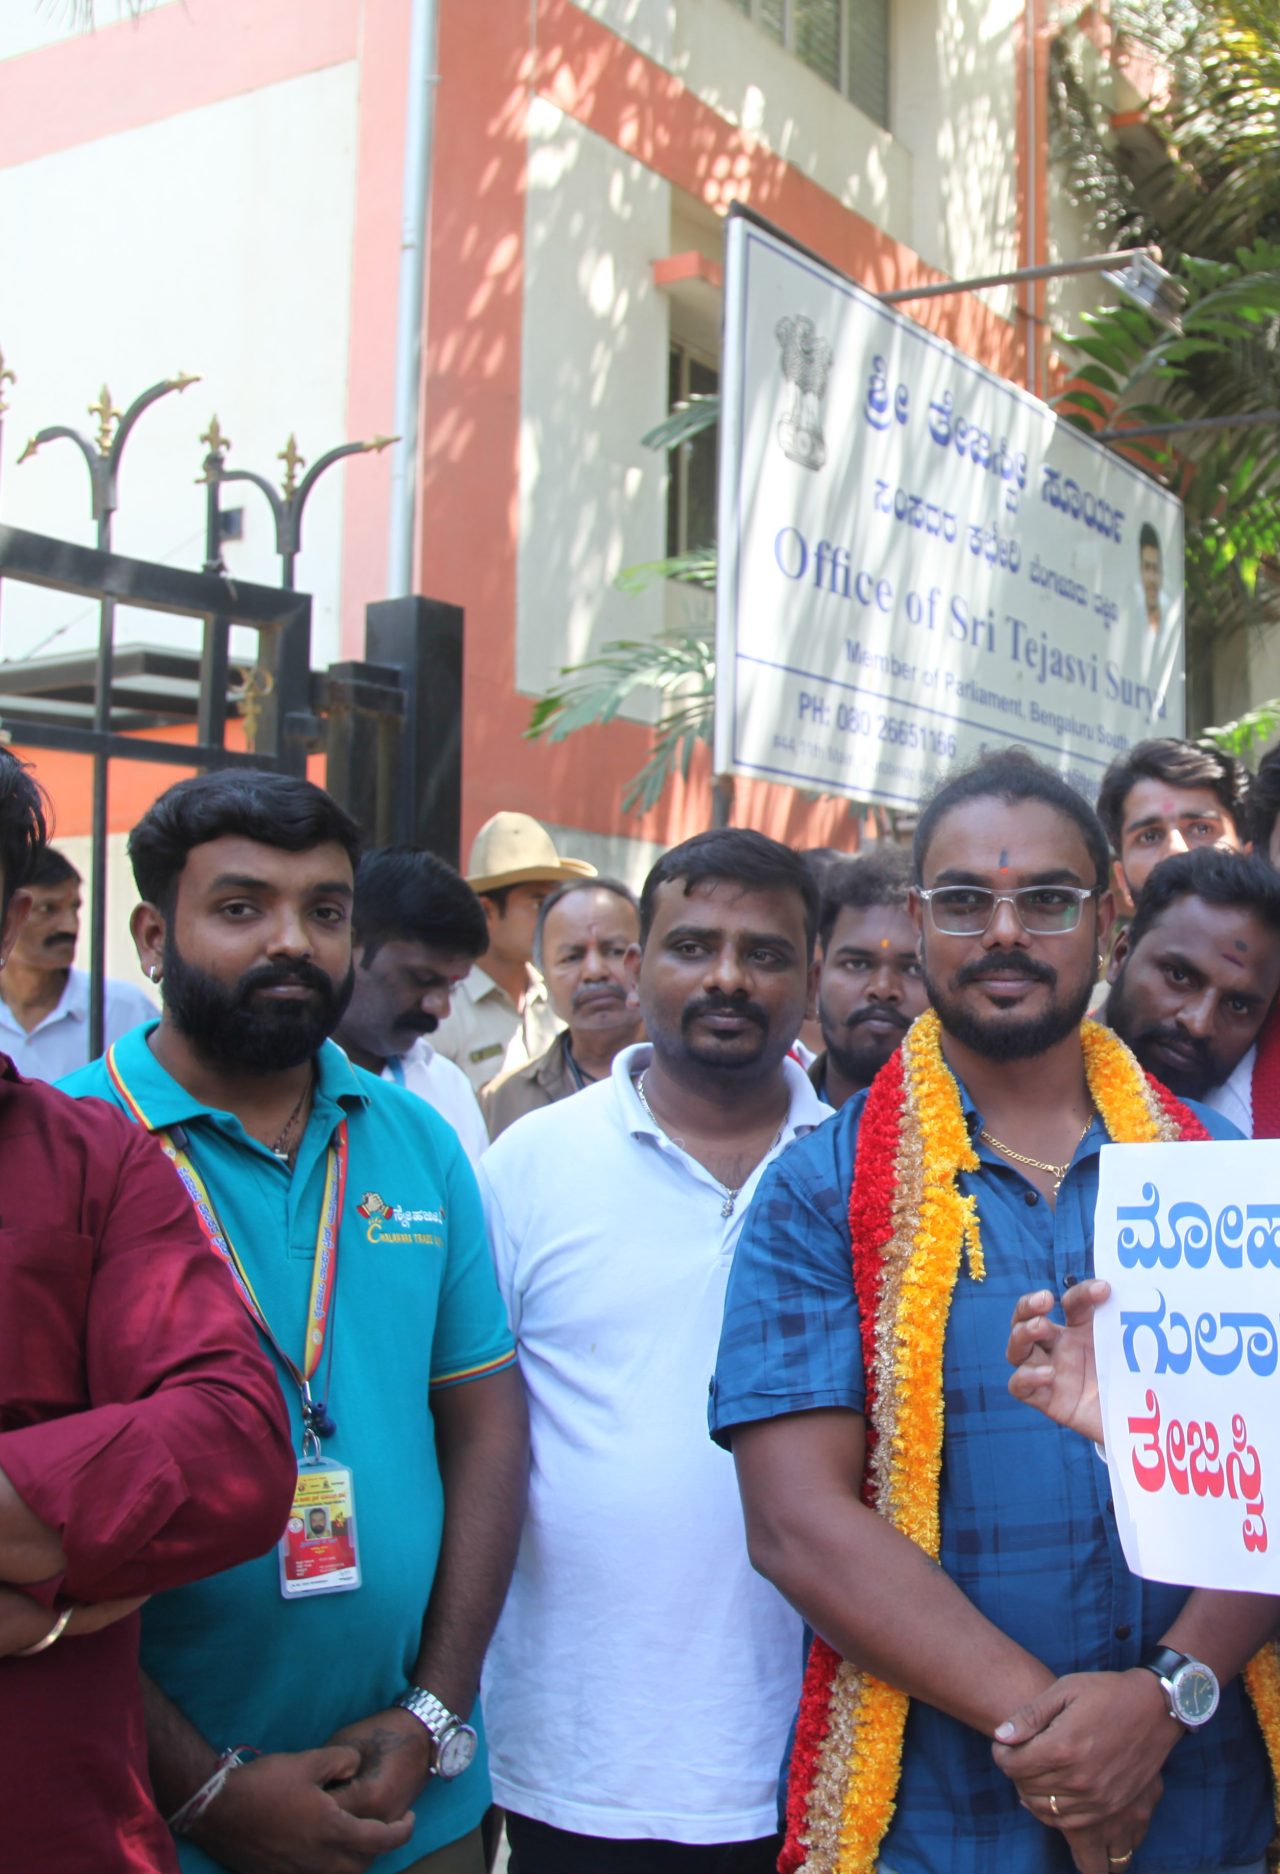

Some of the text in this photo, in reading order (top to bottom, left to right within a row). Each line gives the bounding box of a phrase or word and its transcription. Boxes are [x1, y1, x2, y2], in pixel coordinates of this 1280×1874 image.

[864, 355, 909, 431] ಶ್ರೀ
[929, 390, 1028, 514] ತೇಜಸ್ವಿ
[874, 478, 957, 543] ಸಂಸದರ
[774, 526, 894, 614] Office
[906, 586, 941, 630] of
[950, 594, 996, 653] Sri
[1004, 615, 1099, 685] Tejasvi
[797, 691, 831, 727] PH:
[836, 702, 871, 737] 080
[846, 638, 916, 681] Member
[922, 667, 941, 688] of
[1029, 700, 1095, 741] Bengaluru
[1096, 723, 1131, 751] South
[1127, 1388, 1269, 1554] ತೇಜಸ್ವಿ
